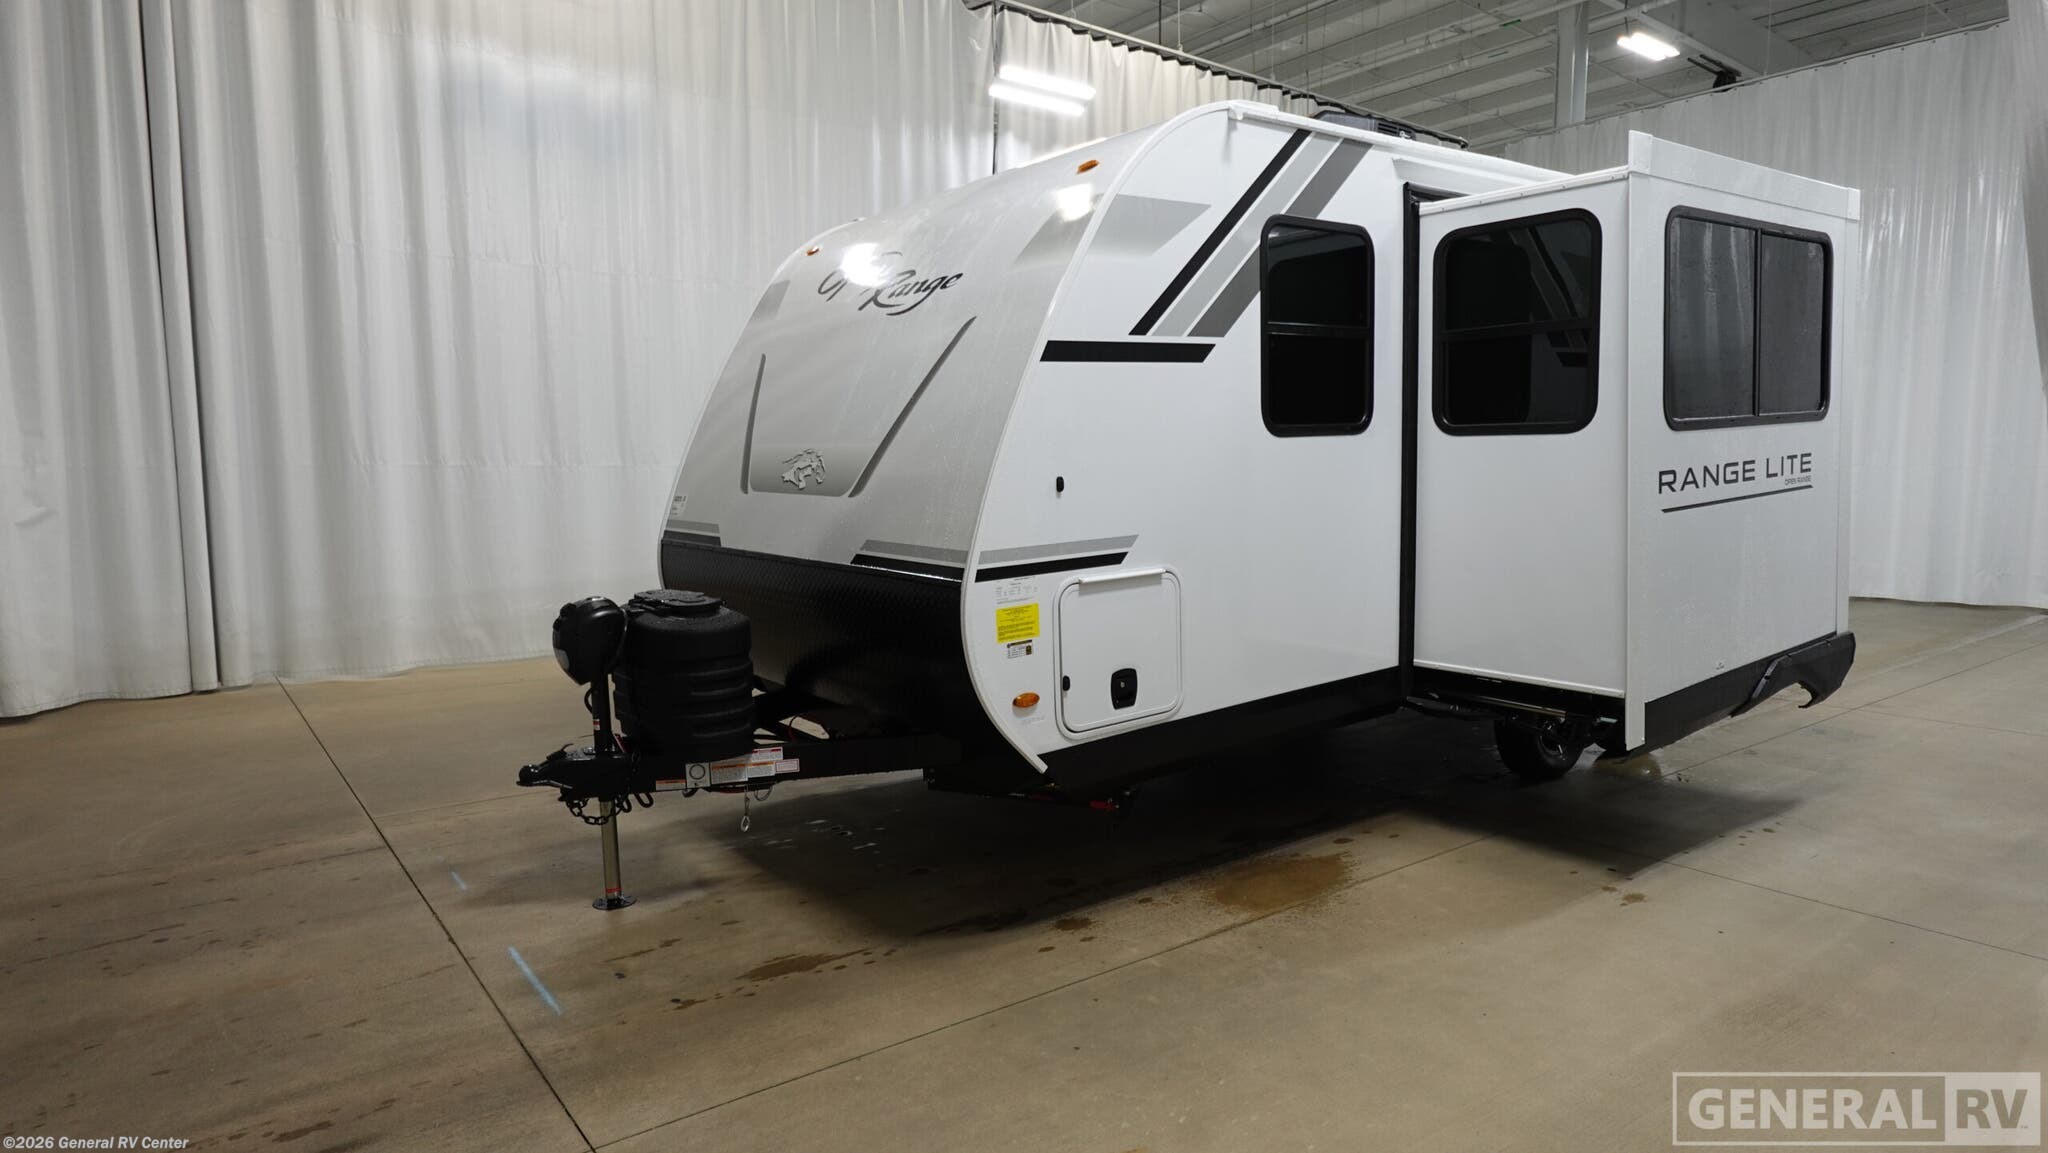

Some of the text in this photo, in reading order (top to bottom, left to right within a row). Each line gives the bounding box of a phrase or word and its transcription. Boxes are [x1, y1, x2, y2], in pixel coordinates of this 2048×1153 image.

[858, 269, 964, 316] Range
[1658, 452, 1812, 494] RANGE LITE
